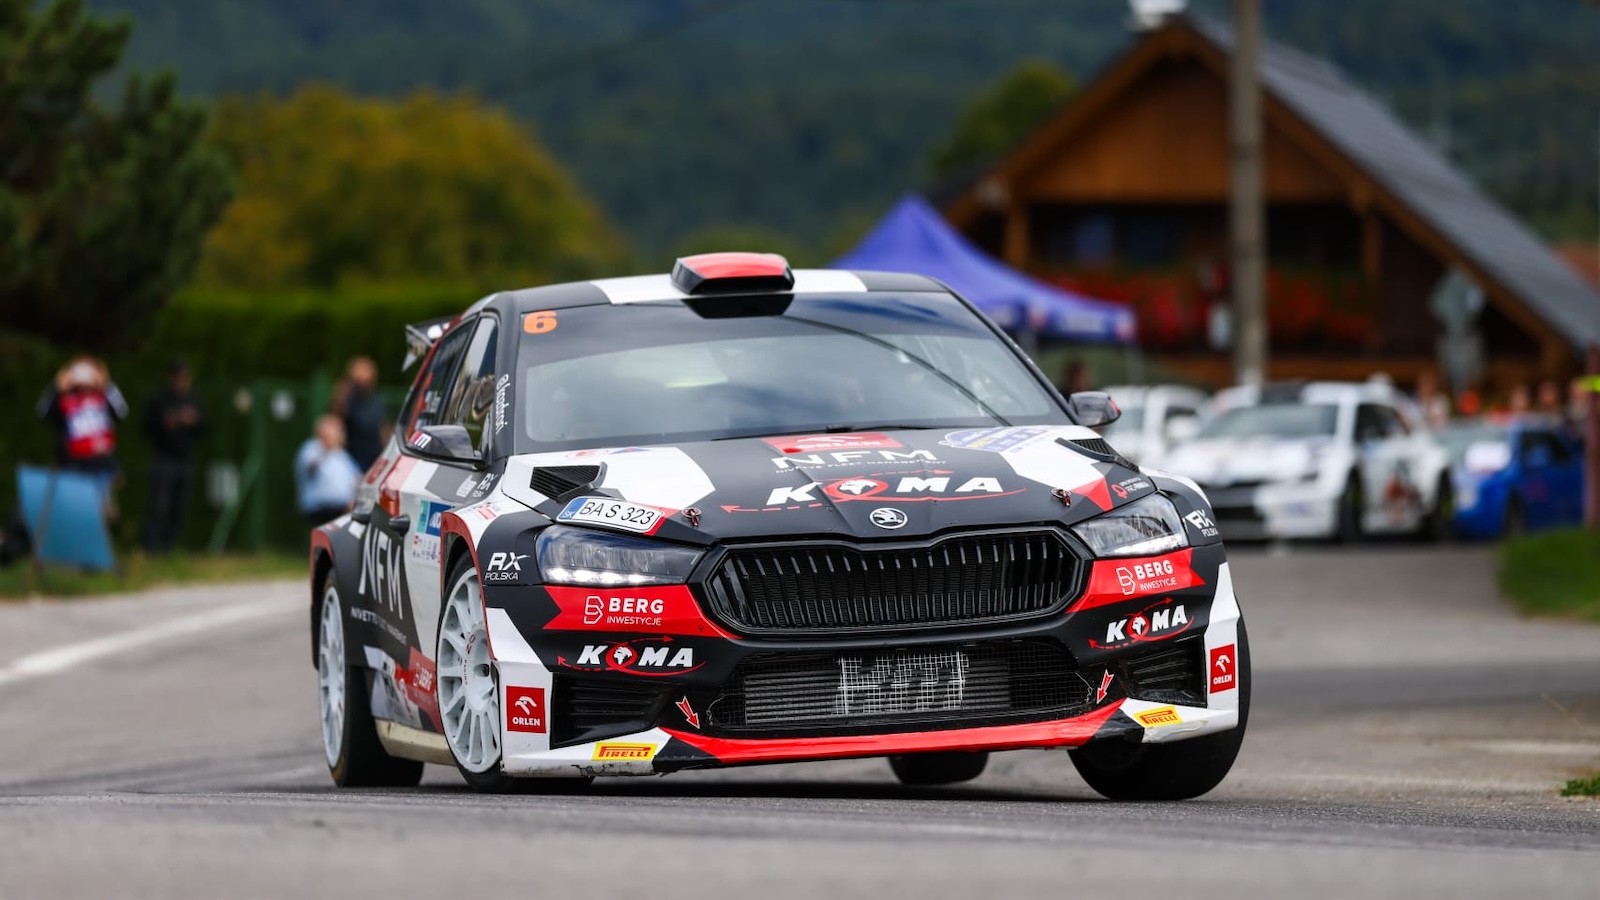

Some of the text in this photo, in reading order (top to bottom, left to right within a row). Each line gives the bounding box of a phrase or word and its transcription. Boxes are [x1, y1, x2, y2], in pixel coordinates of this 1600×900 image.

[523, 310, 557, 334] 6
[771, 450, 937, 469] NFM
[621, 507, 655, 525] 323
[487, 551, 530, 571] RX
[358, 521, 403, 620] NFM
[484, 572, 519, 581] POLSKA
[1133, 560, 1173, 580] BERG
[1139, 577, 1177, 591] INWESTYCJE
[608, 597, 664, 614] BERG
[606, 616, 662, 626] INWESTYCJE
[1213, 673, 1233, 685] ORLEN
[512, 716, 541, 726] ORLEN
[1140, 710, 1178, 725] PIRELLI
[598, 746, 652, 758] PIRELLI
